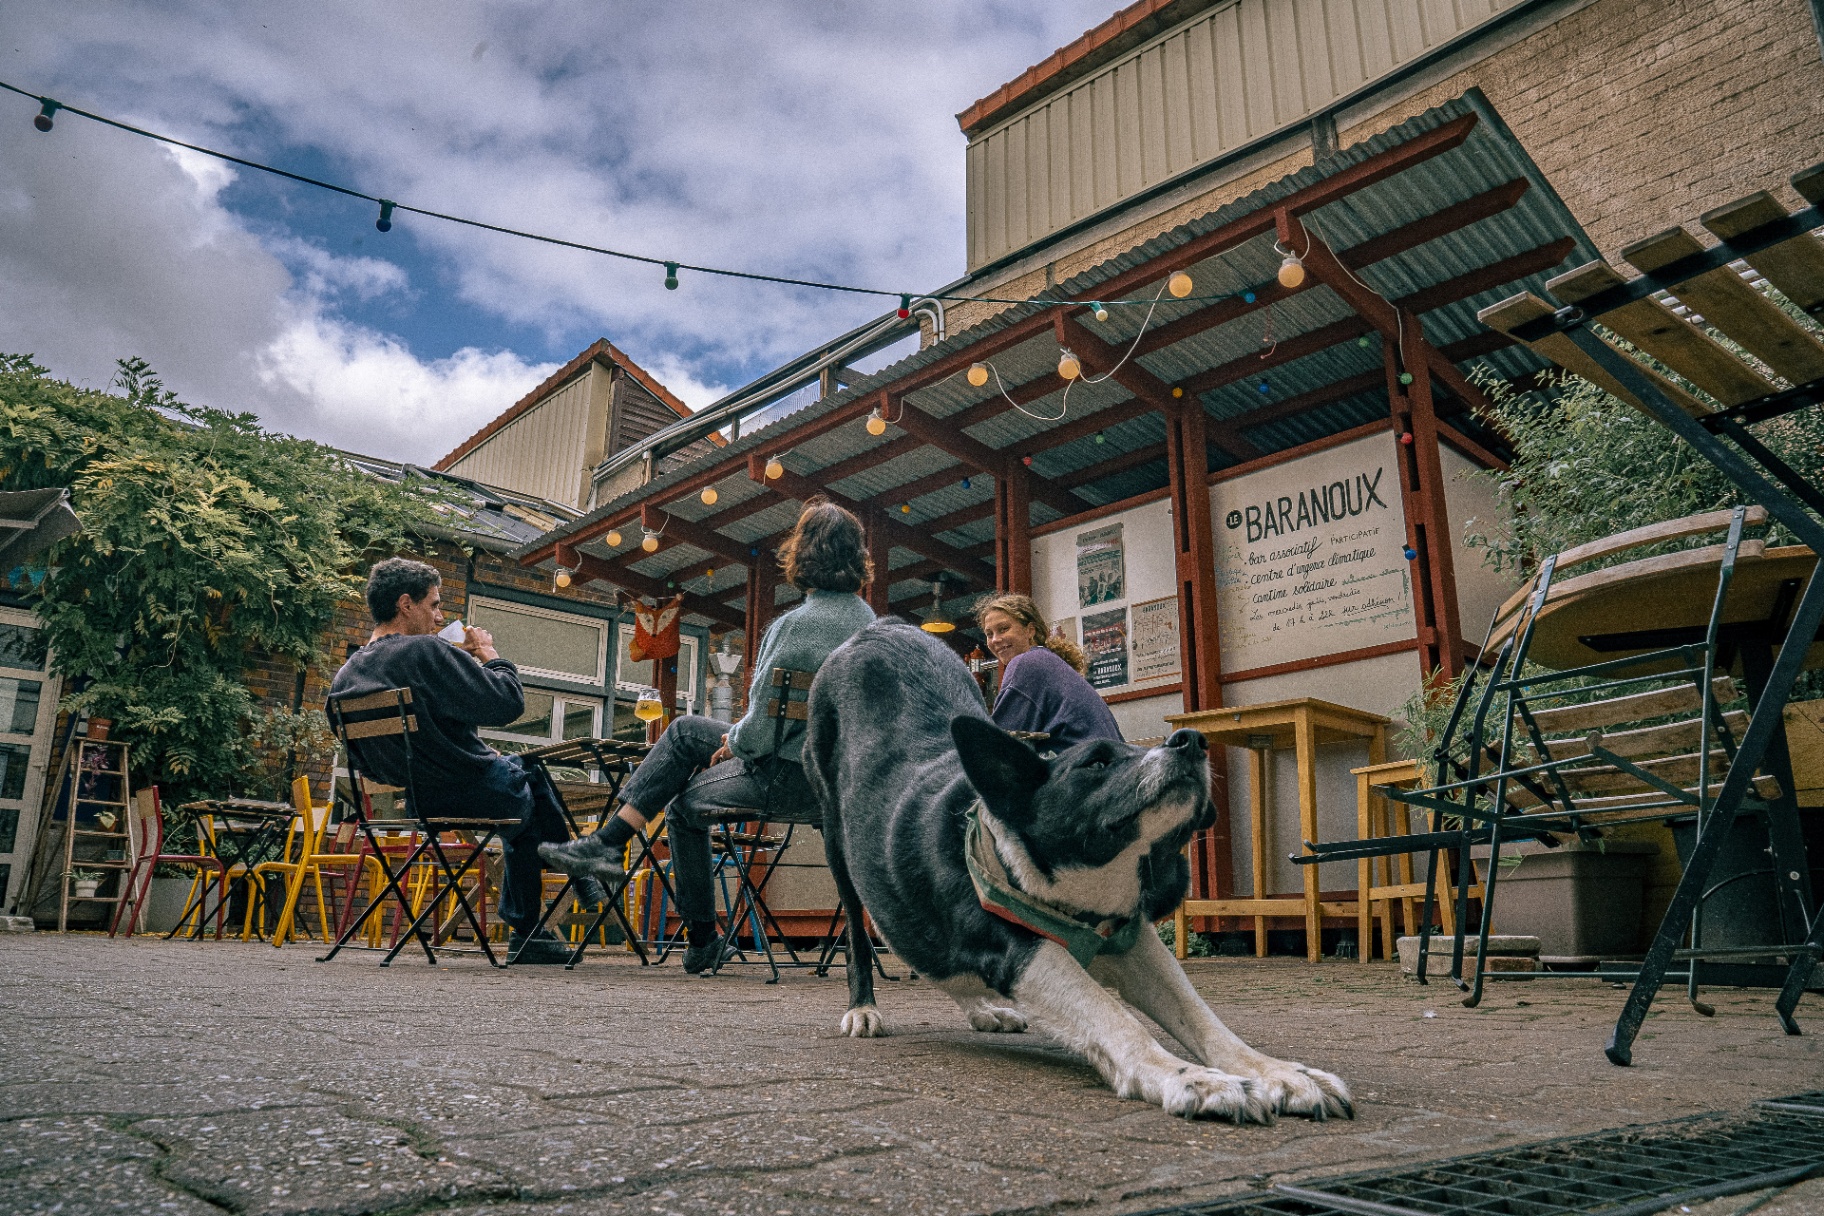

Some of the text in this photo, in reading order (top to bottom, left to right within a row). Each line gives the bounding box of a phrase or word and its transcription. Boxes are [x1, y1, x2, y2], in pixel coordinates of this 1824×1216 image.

[1245, 467, 1388, 544] BARANOUX
[1248, 551, 1267, 566] bar
[1269, 536, 1324, 559] associatif
[1250, 568, 1284, 585] centre
[1327, 547, 1377, 567] climatique
[1292, 577, 1338, 597] solidaire
